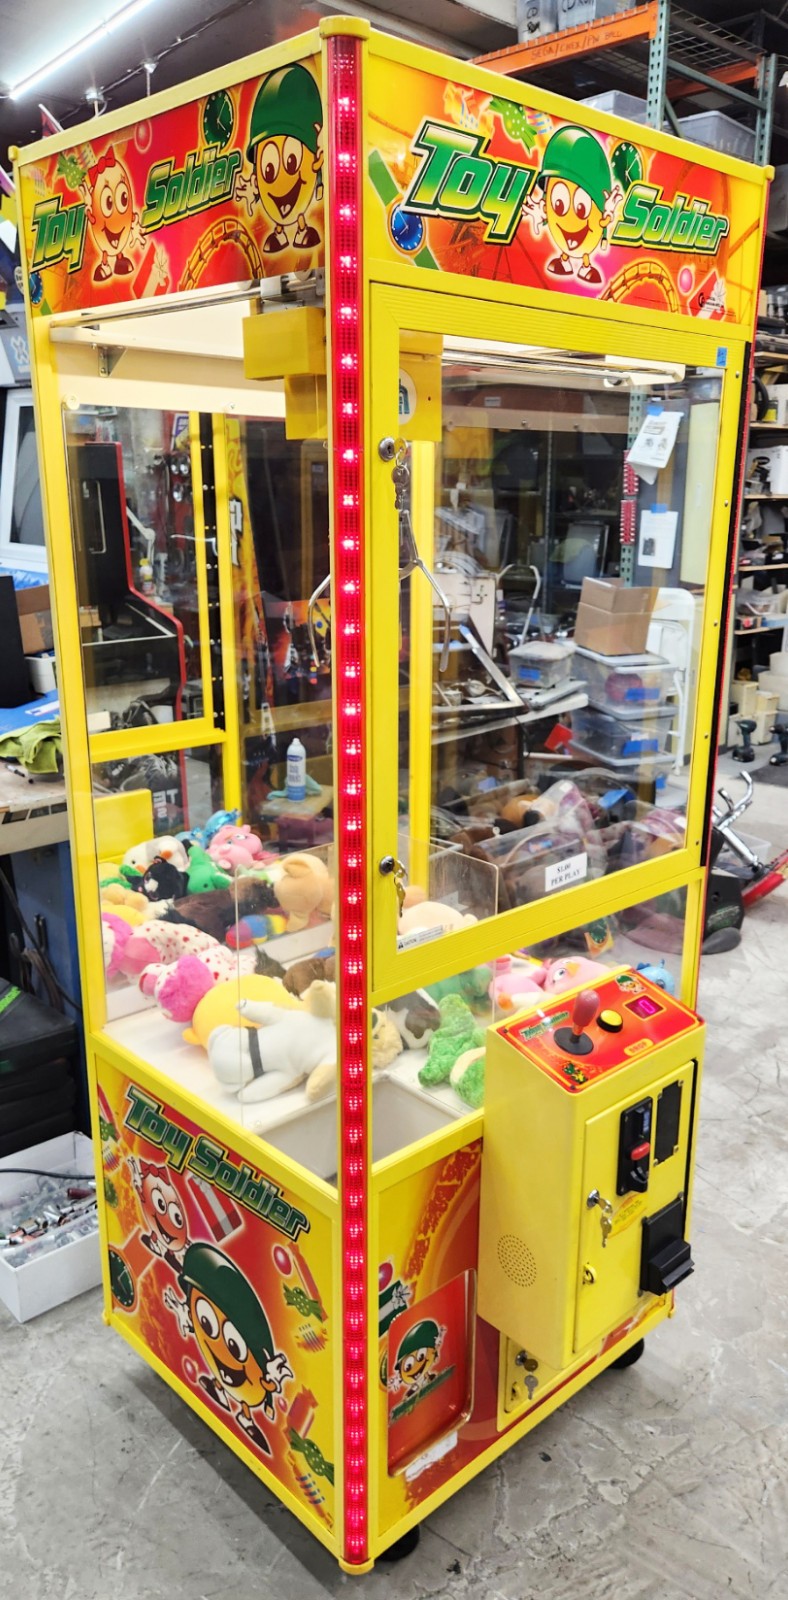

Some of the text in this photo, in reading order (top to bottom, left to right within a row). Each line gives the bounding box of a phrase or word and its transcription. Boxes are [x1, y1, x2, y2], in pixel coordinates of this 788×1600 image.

[30, 146, 244, 274] Toy Soldier
[403, 119, 729, 256] Toy Soldier
[551, 868, 581, 886] PER PLAY
[124, 1084, 311, 1242] Toy Soldier
